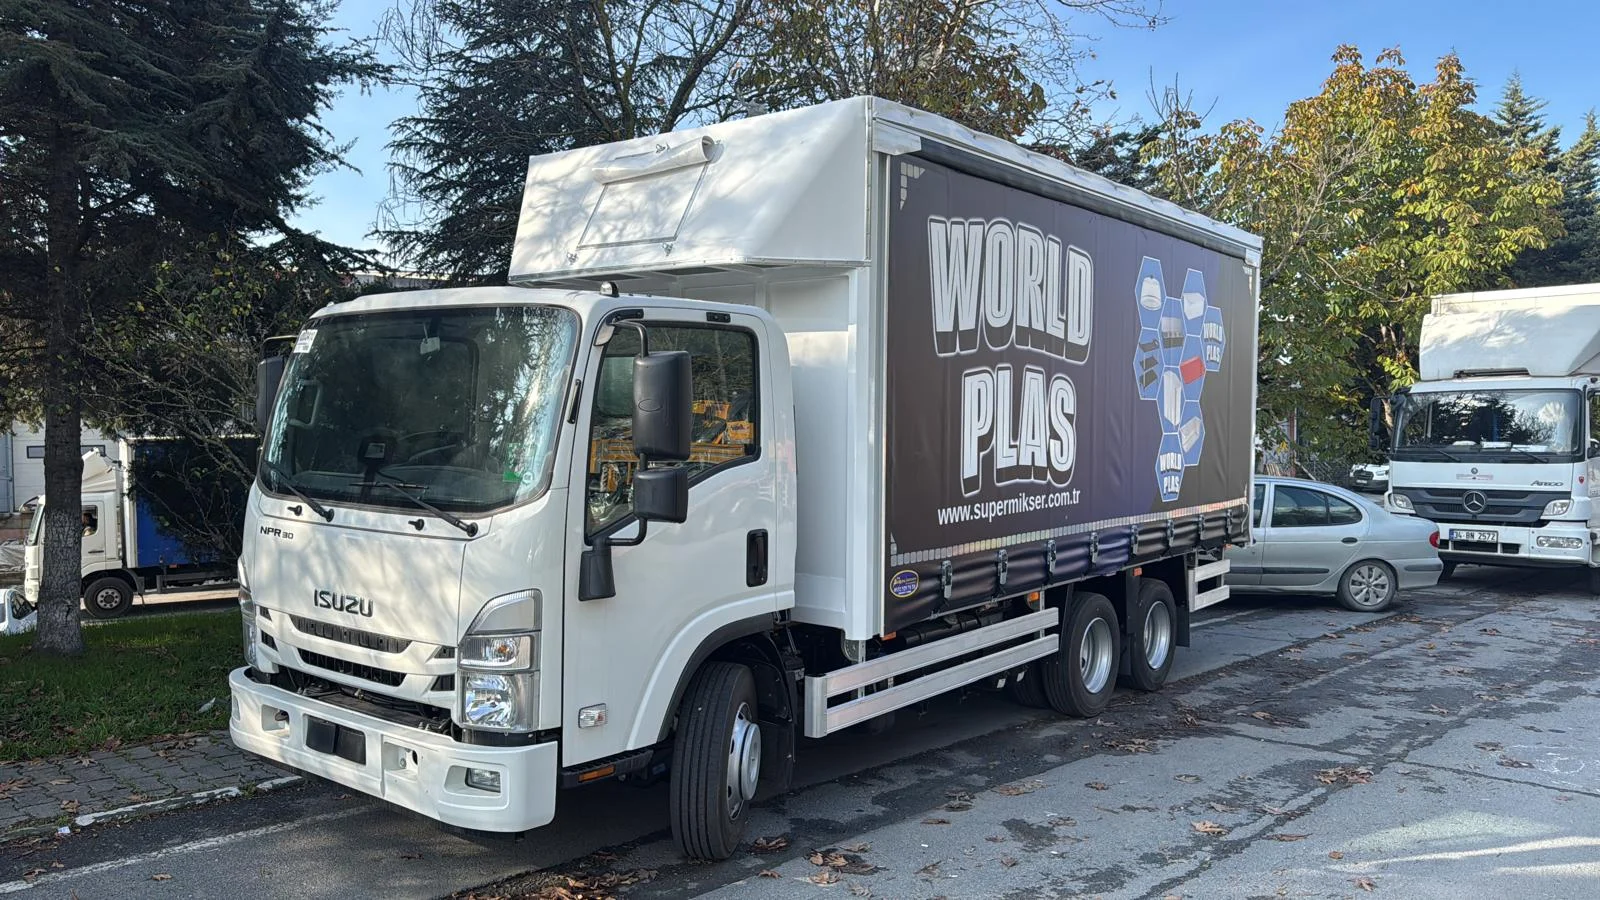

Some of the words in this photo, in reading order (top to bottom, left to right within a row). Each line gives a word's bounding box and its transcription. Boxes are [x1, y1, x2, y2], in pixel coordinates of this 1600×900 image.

[928, 216, 1093, 364] WORLD
[1201, 322, 1222, 342] WORLD
[1206, 344, 1220, 363] PLAS
[961, 363, 1076, 497] PLAS
[1160, 452, 1182, 472] WORLD
[1163, 475, 1179, 494] PLAS
[937, 488, 1081, 526] www.supermikser.com.tr
[260, 526, 281, 537] NPR
[282, 532, 294, 540] 30
[1454, 531, 1462, 539] 34
[1478, 532, 1496, 541] 2572
[313, 588, 374, 618] ISUZU
